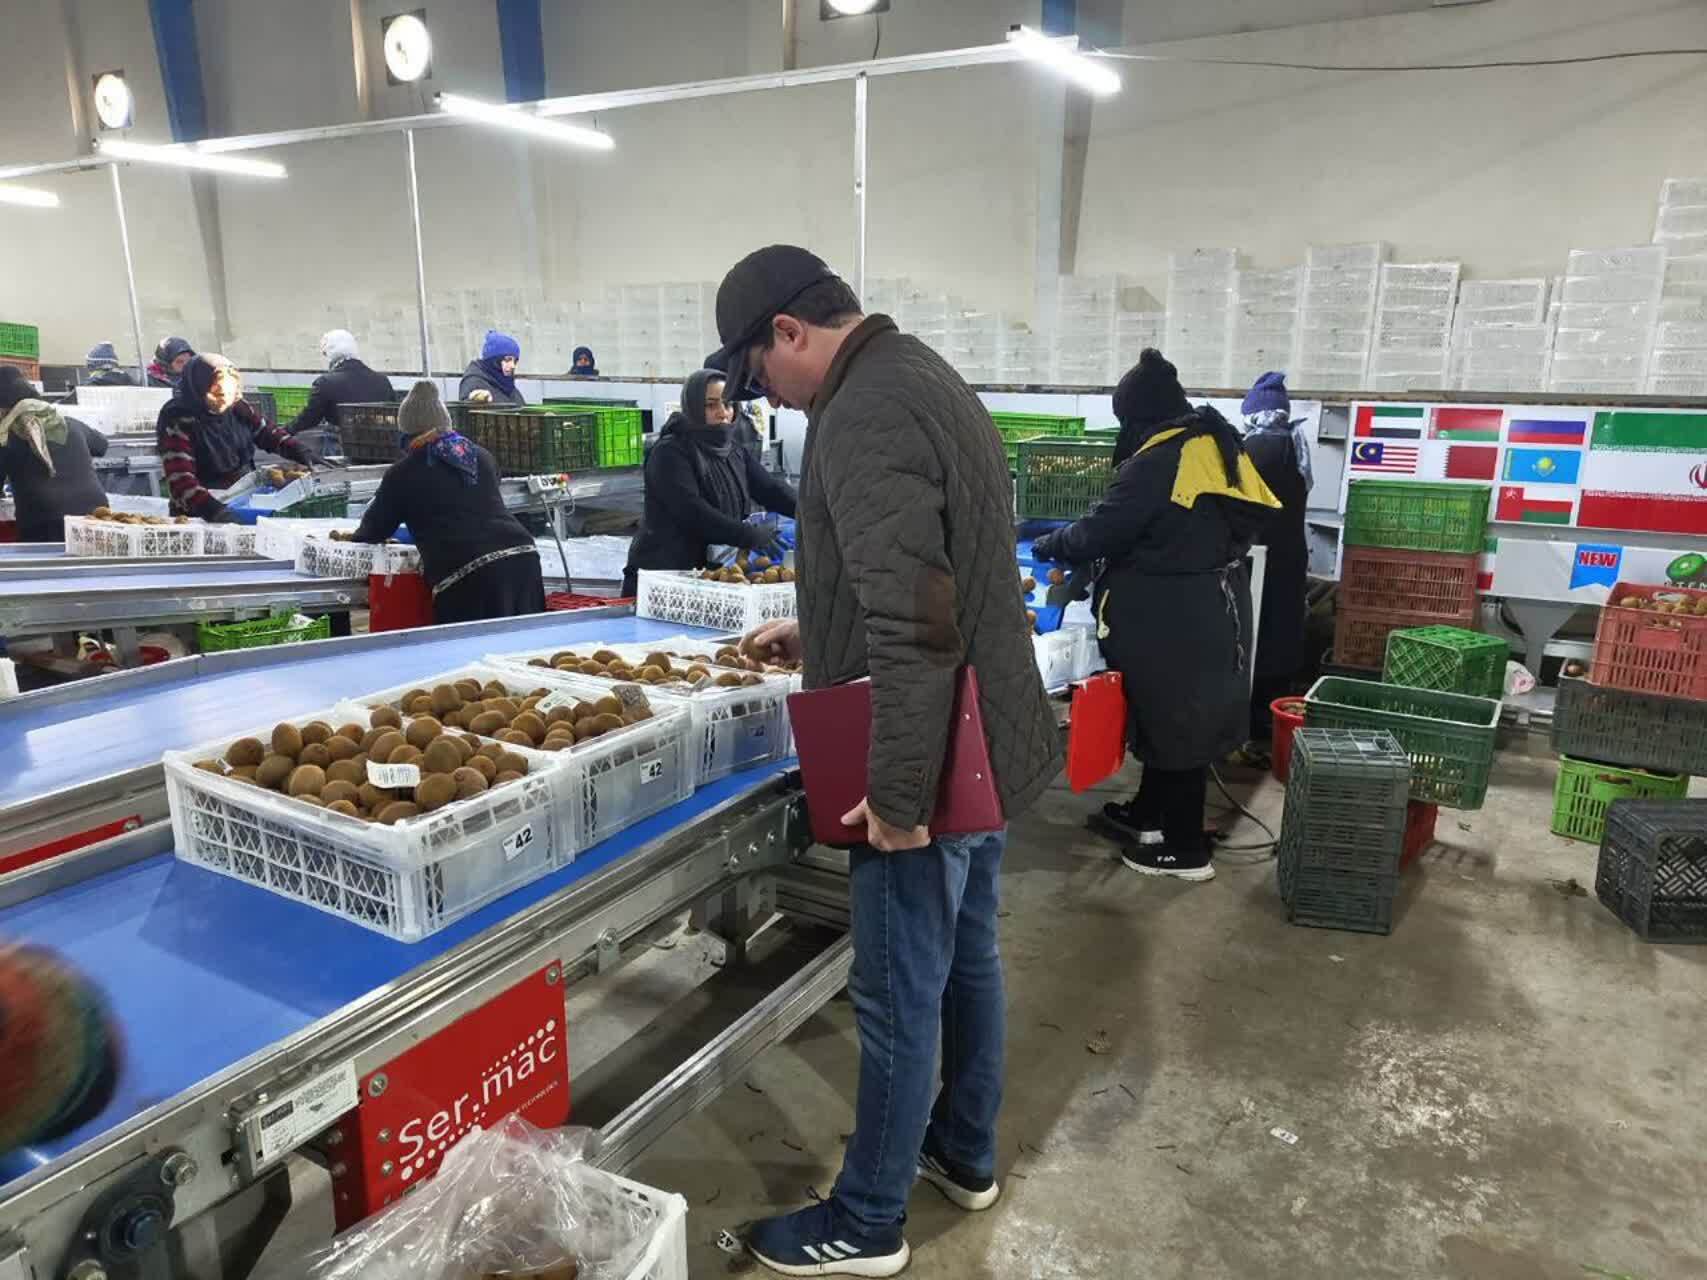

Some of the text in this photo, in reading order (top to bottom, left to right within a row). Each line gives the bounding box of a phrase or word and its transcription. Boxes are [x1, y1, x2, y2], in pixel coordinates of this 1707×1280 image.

[1578, 550, 1618, 568] NEW
[649, 762, 662, 777] 42
[516, 828, 533, 848] 42
[398, 1035, 556, 1164] Ser.mac
